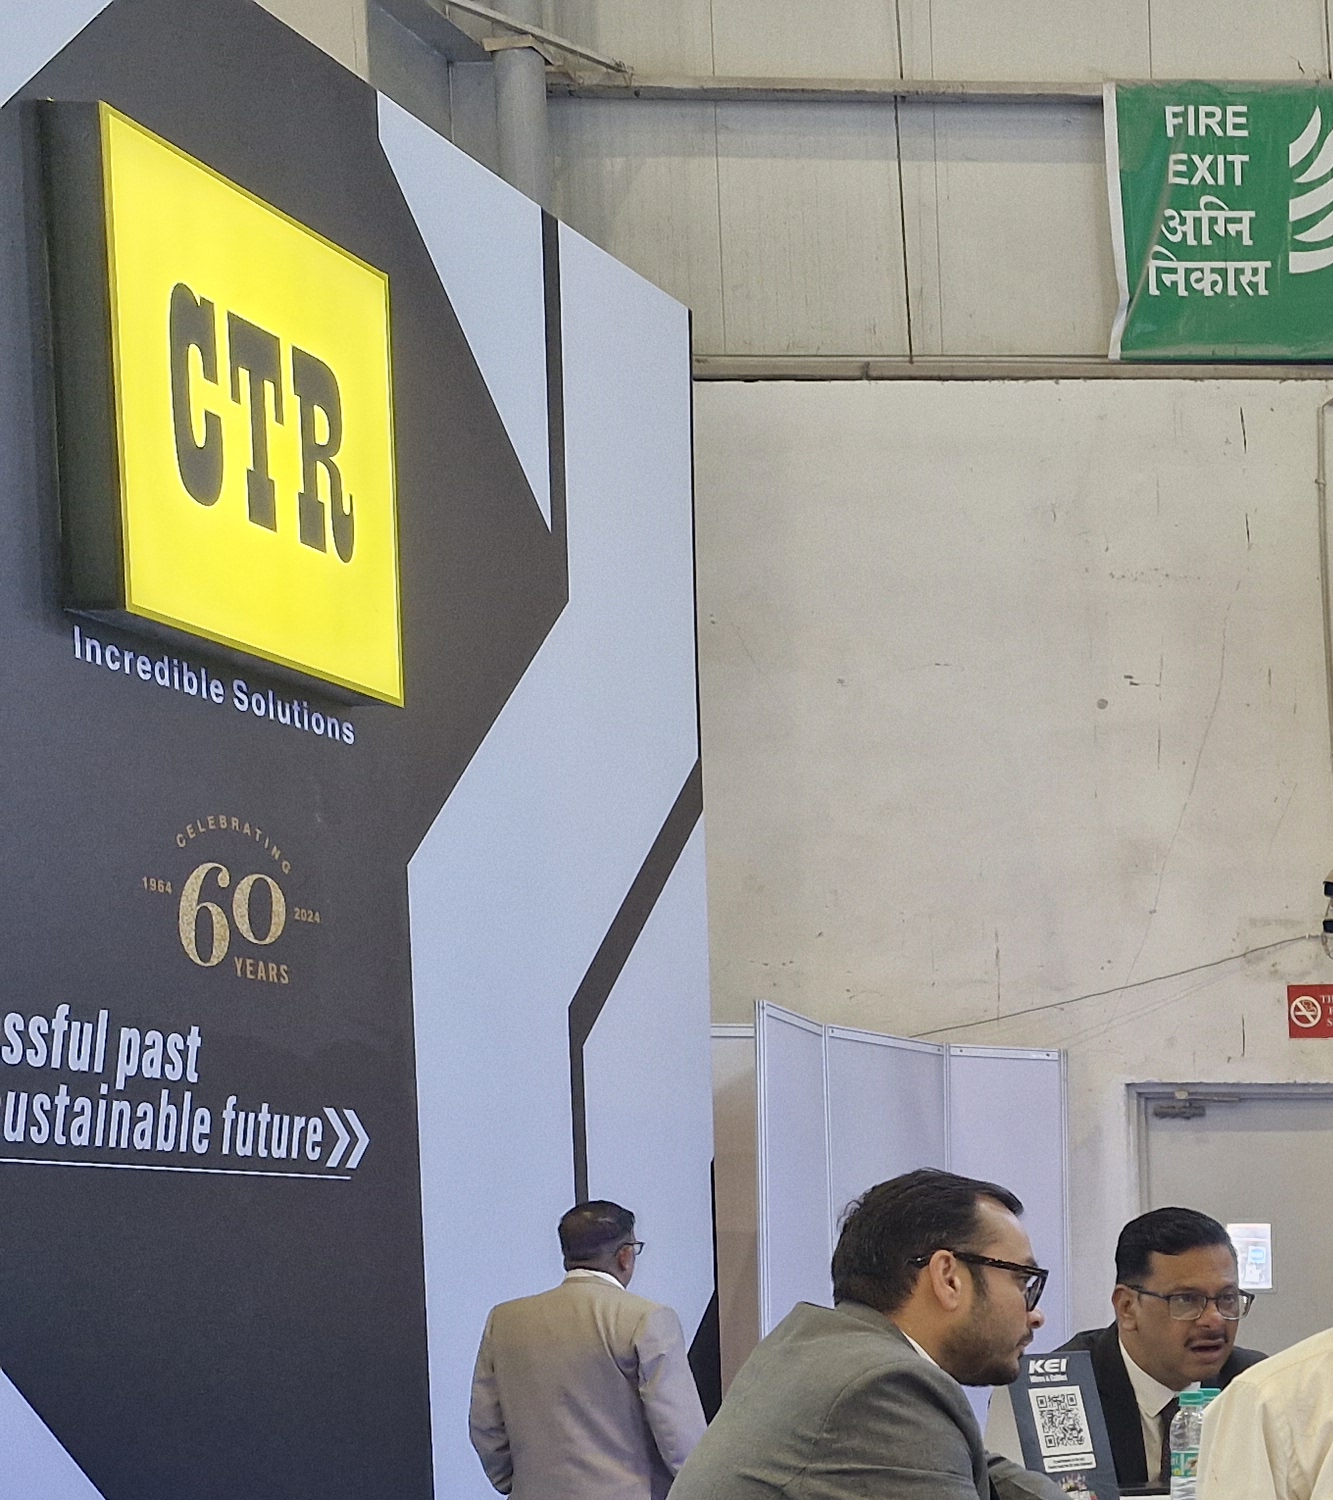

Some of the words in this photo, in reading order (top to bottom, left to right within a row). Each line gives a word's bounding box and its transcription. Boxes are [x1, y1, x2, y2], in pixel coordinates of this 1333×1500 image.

[1165, 104, 1249, 138] FIRE
[1167, 153, 1249, 186] EXIT
[1160, 195, 1255, 246] अग्नि
[1147, 245, 1271, 296] निकास
[169, 282, 355, 563] CTR
[72, 624, 226, 704] Incredible
[232, 678, 356, 745] Solutions
[176, 815, 292, 874] CELEBRATING
[142, 876, 173, 894] 1964
[178, 862, 286, 967] 60
[294, 907, 321, 923] 2024
[234, 956, 290, 985] YEARS
[1, 1003, 110, 1073] ssful
[115, 1025, 202, 1090] past
[3, 1083, 212, 1155] ustainable
[222, 1095, 324, 1161] future
[1028, 1358, 1068, 1375] KEI
